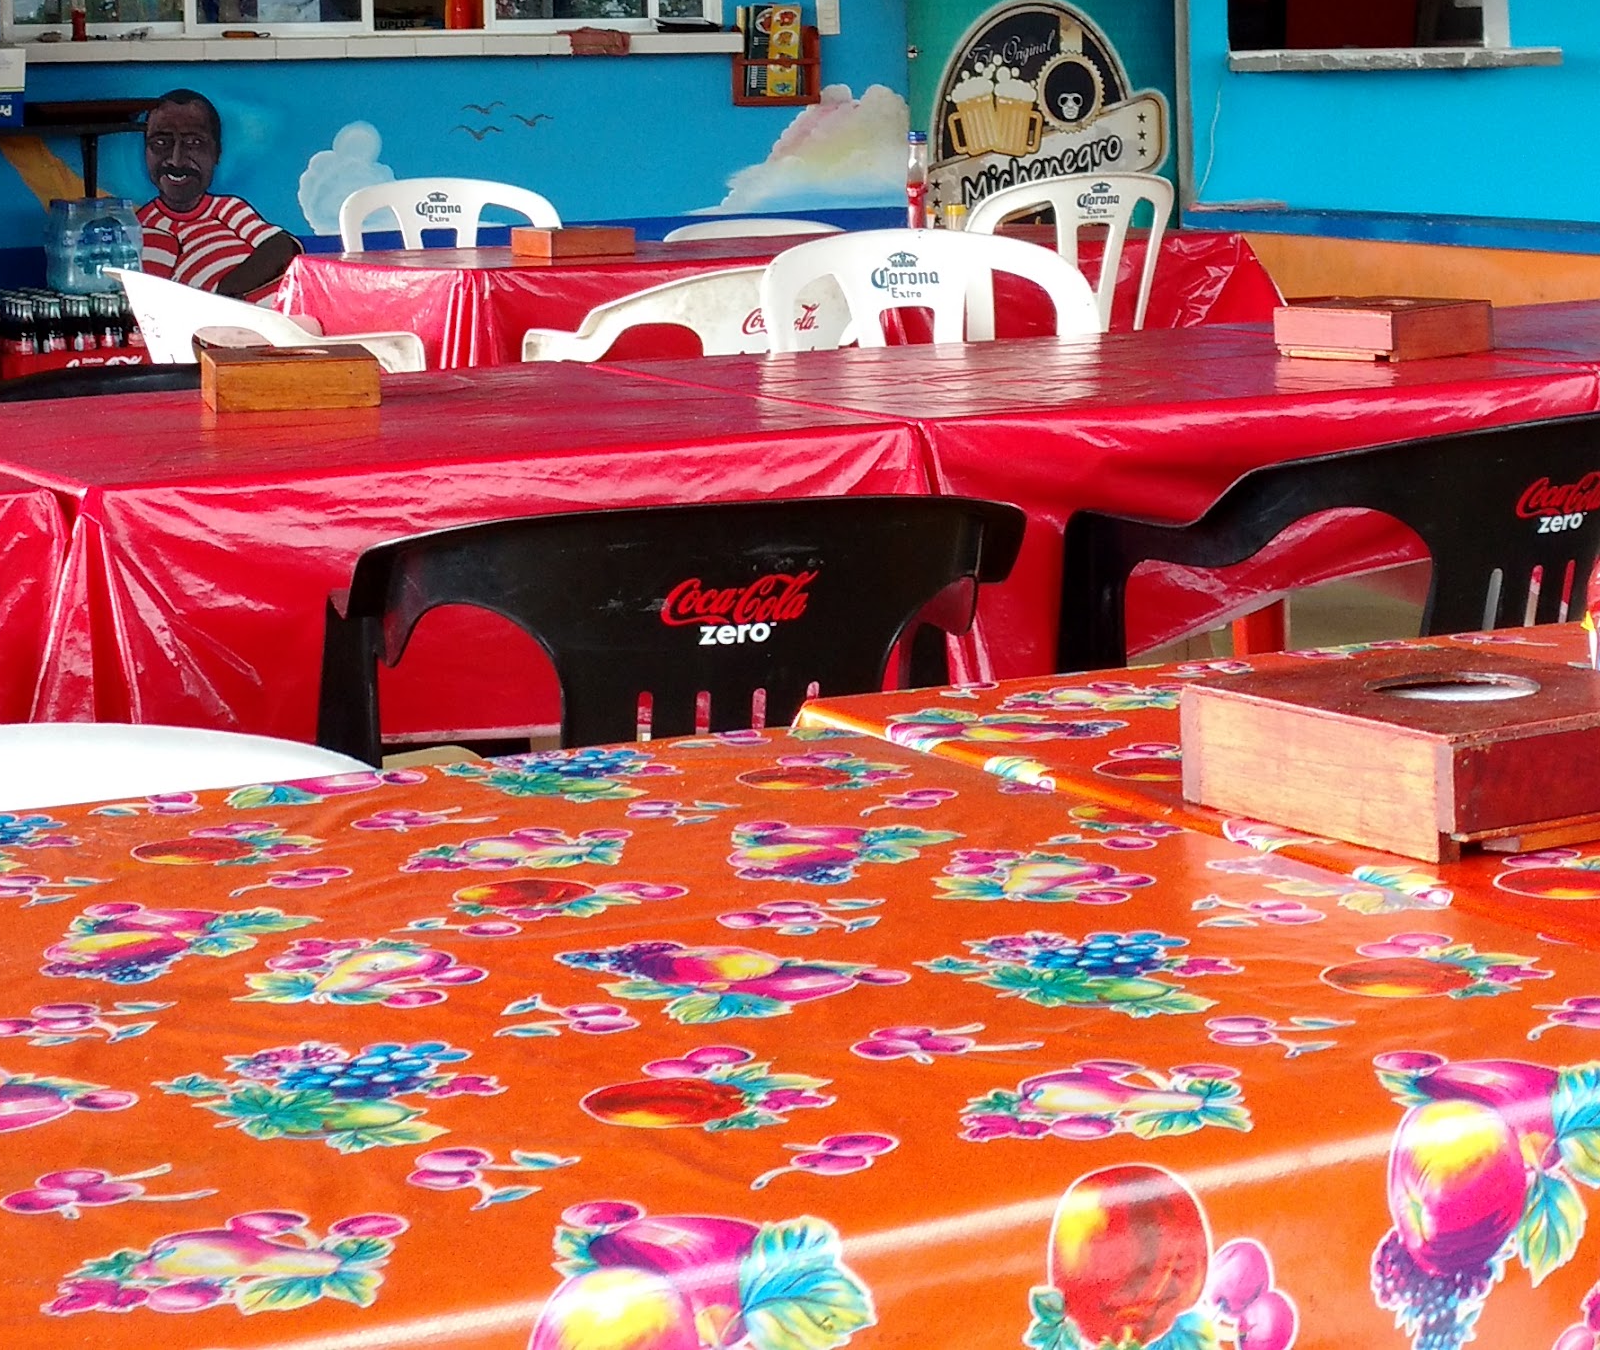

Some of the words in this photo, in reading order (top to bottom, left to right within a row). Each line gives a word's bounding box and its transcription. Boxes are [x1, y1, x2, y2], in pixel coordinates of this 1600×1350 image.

[1002, 29, 1055, 67] Original
[415, 201, 461, 217] Corona
[1077, 193, 1119, 209] Corona
[871, 267, 940, 291] Corona
[891, 287, 922, 298] Extra
[1537, 513, 1584, 534] zero
[660, 570, 818, 626] Coca-Cola
[699, 622, 771, 645] zero
